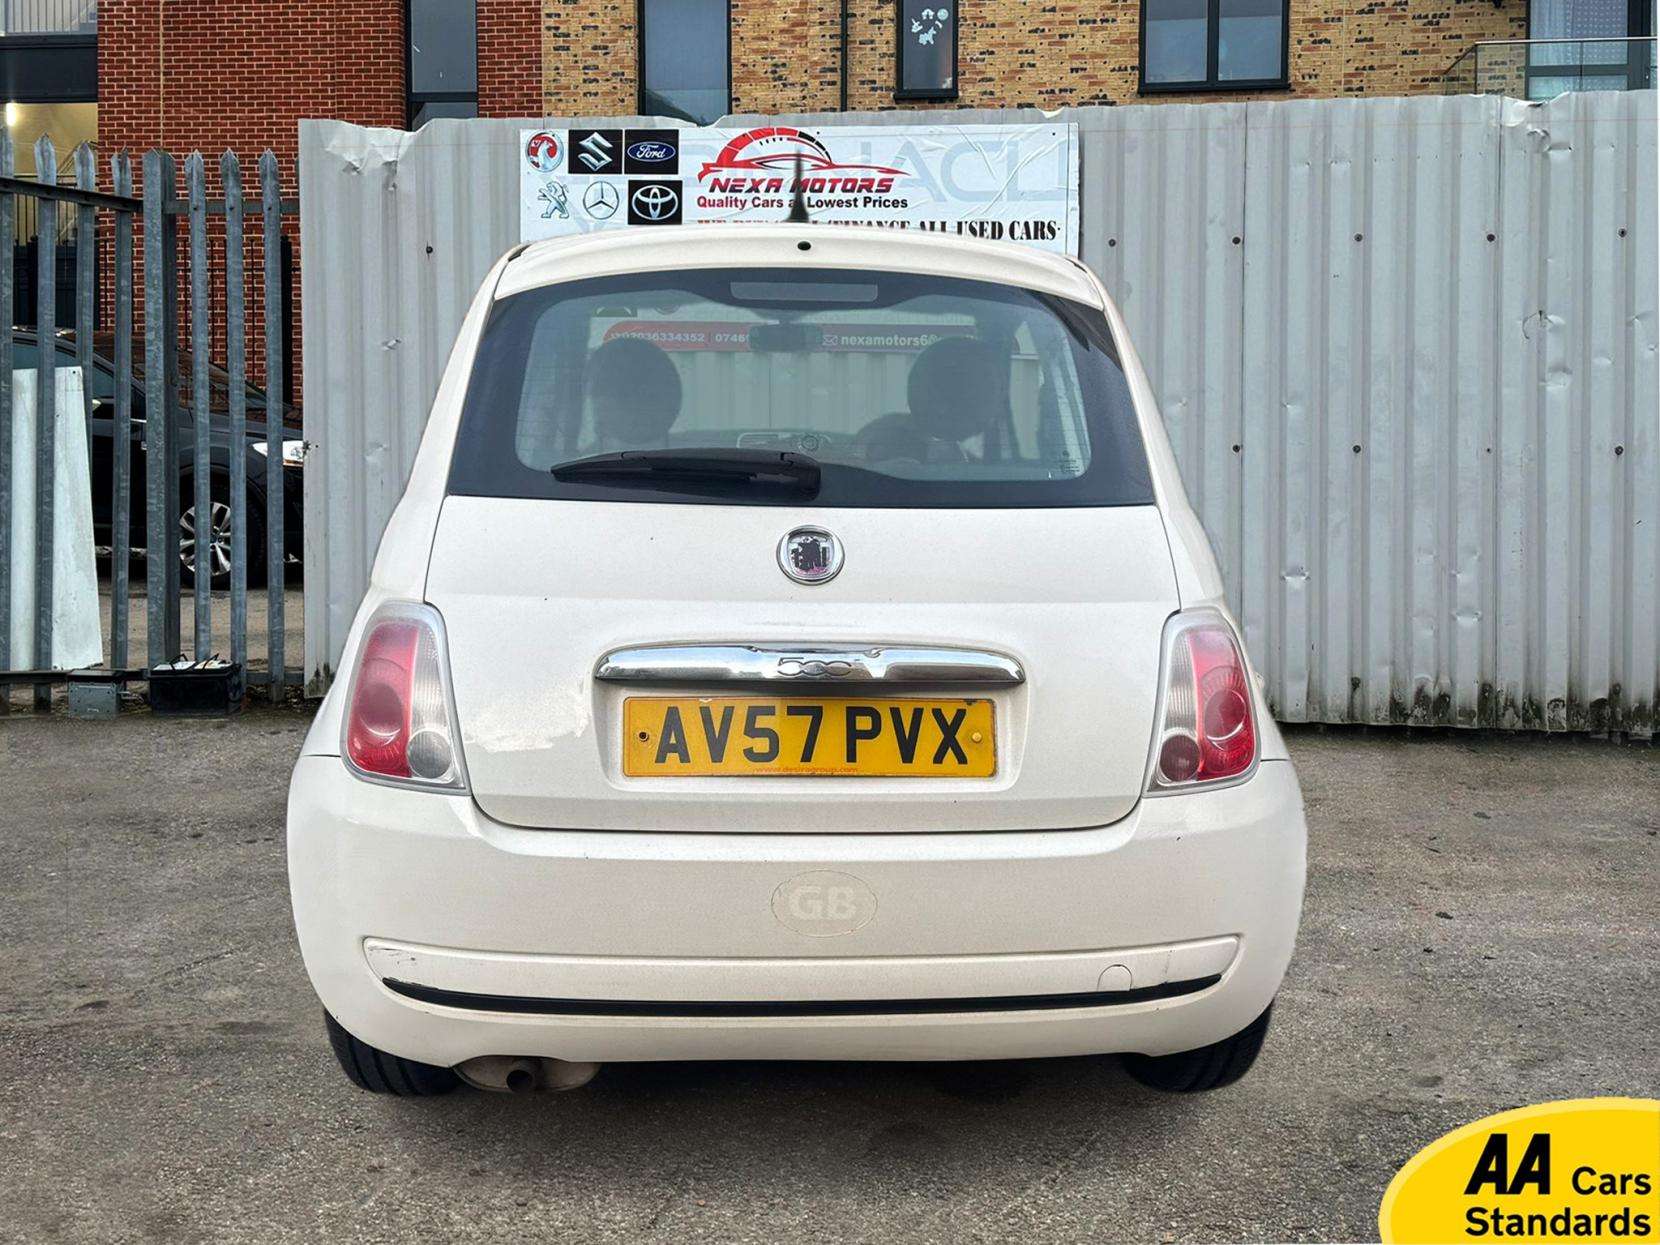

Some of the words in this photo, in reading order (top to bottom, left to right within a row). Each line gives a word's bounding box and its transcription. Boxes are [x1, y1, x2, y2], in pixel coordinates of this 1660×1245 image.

[636, 144, 666, 159] Ford
[708, 177, 784, 194] NEXA
[789, 177, 894, 194] MOTORS
[697, 195, 746, 211] Quality
[751, 196, 783, 208] Cars
[806, 196, 859, 208] Lowest
[862, 196, 908, 208] Prices
[956, 220, 1004, 240] USED
[1008, 220, 1057, 241] CARS
[777, 656, 852, 676] 500
[654, 705, 824, 764] AV57
[845, 706, 968, 765] PVX
[789, 884, 857, 920] GB
